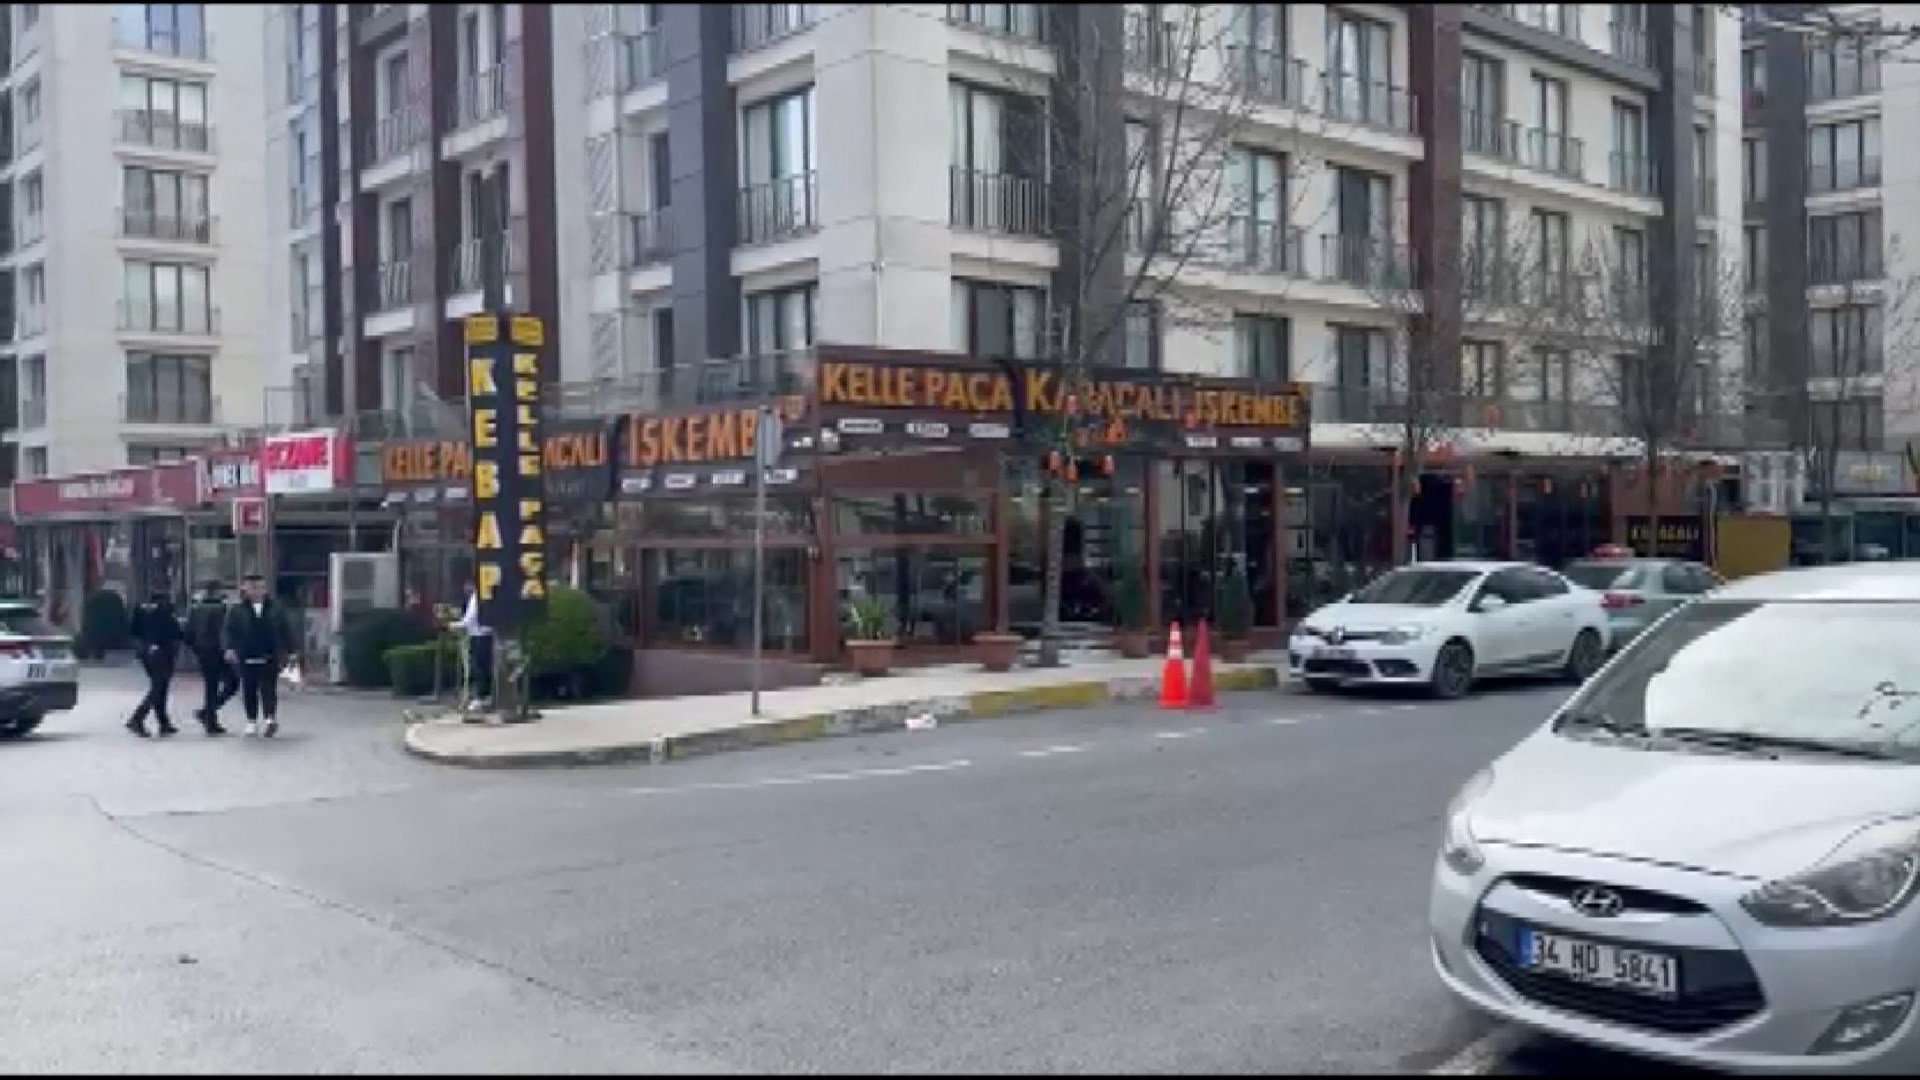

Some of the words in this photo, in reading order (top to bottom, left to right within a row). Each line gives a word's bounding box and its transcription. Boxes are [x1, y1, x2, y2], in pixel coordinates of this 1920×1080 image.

[513, 353, 541, 475] KELLE
[824, 363, 915, 405] KELLE
[927, 367, 1014, 419] PAÇA
[471, 358, 502, 600] KEBAP
[1533, 933, 1561, 964] 34
[1613, 949, 1671, 989] 5841
